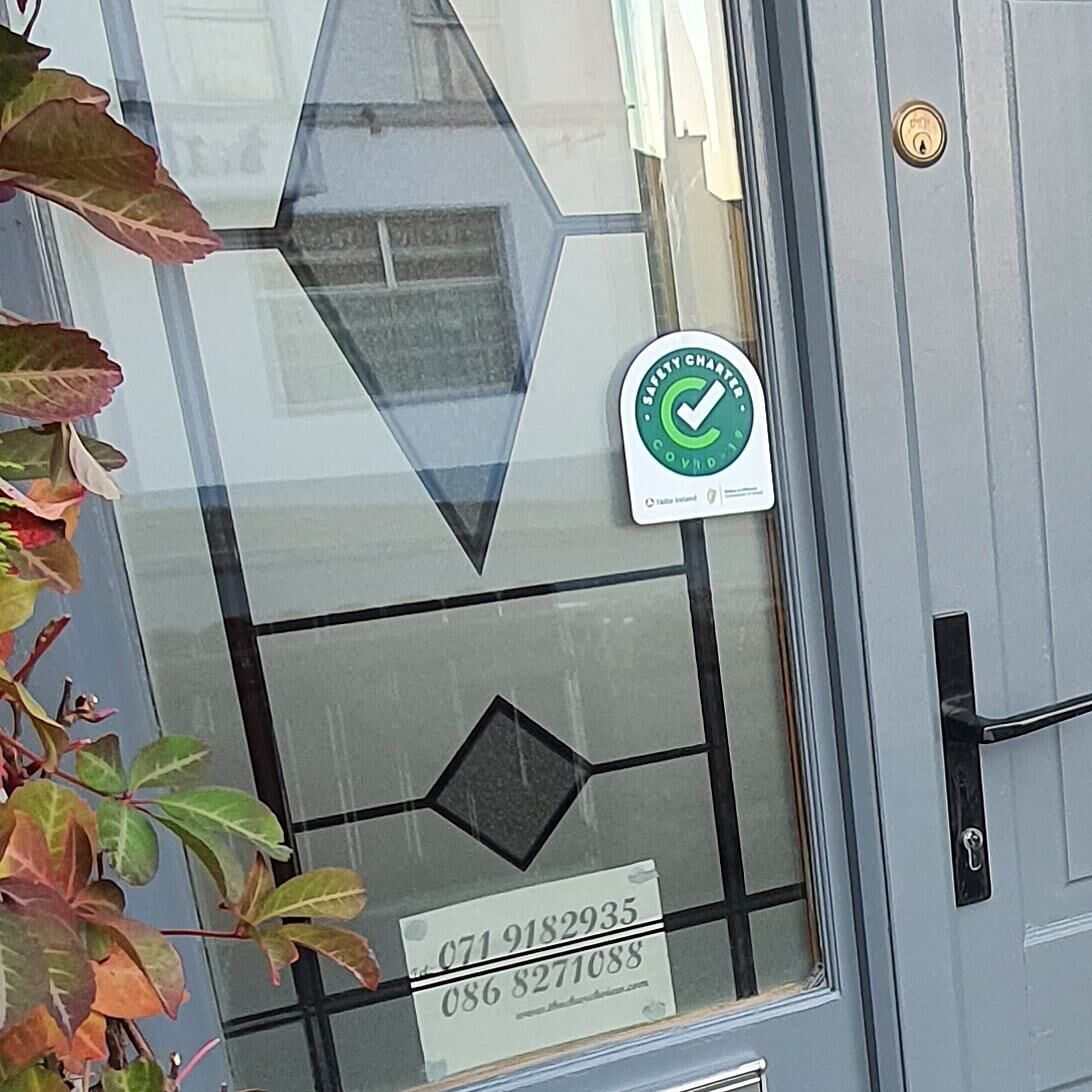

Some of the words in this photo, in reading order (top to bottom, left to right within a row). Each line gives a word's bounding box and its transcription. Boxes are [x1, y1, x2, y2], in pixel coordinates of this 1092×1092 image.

[642, 355, 681, 406] SAFETY
[684, 353, 745, 399] CHARTER
[438, 930, 491, 971] 071
[502, 897, 639, 953] 9182935
[441, 976, 501, 1018] 086
[511, 939, 644, 998] 8271088
